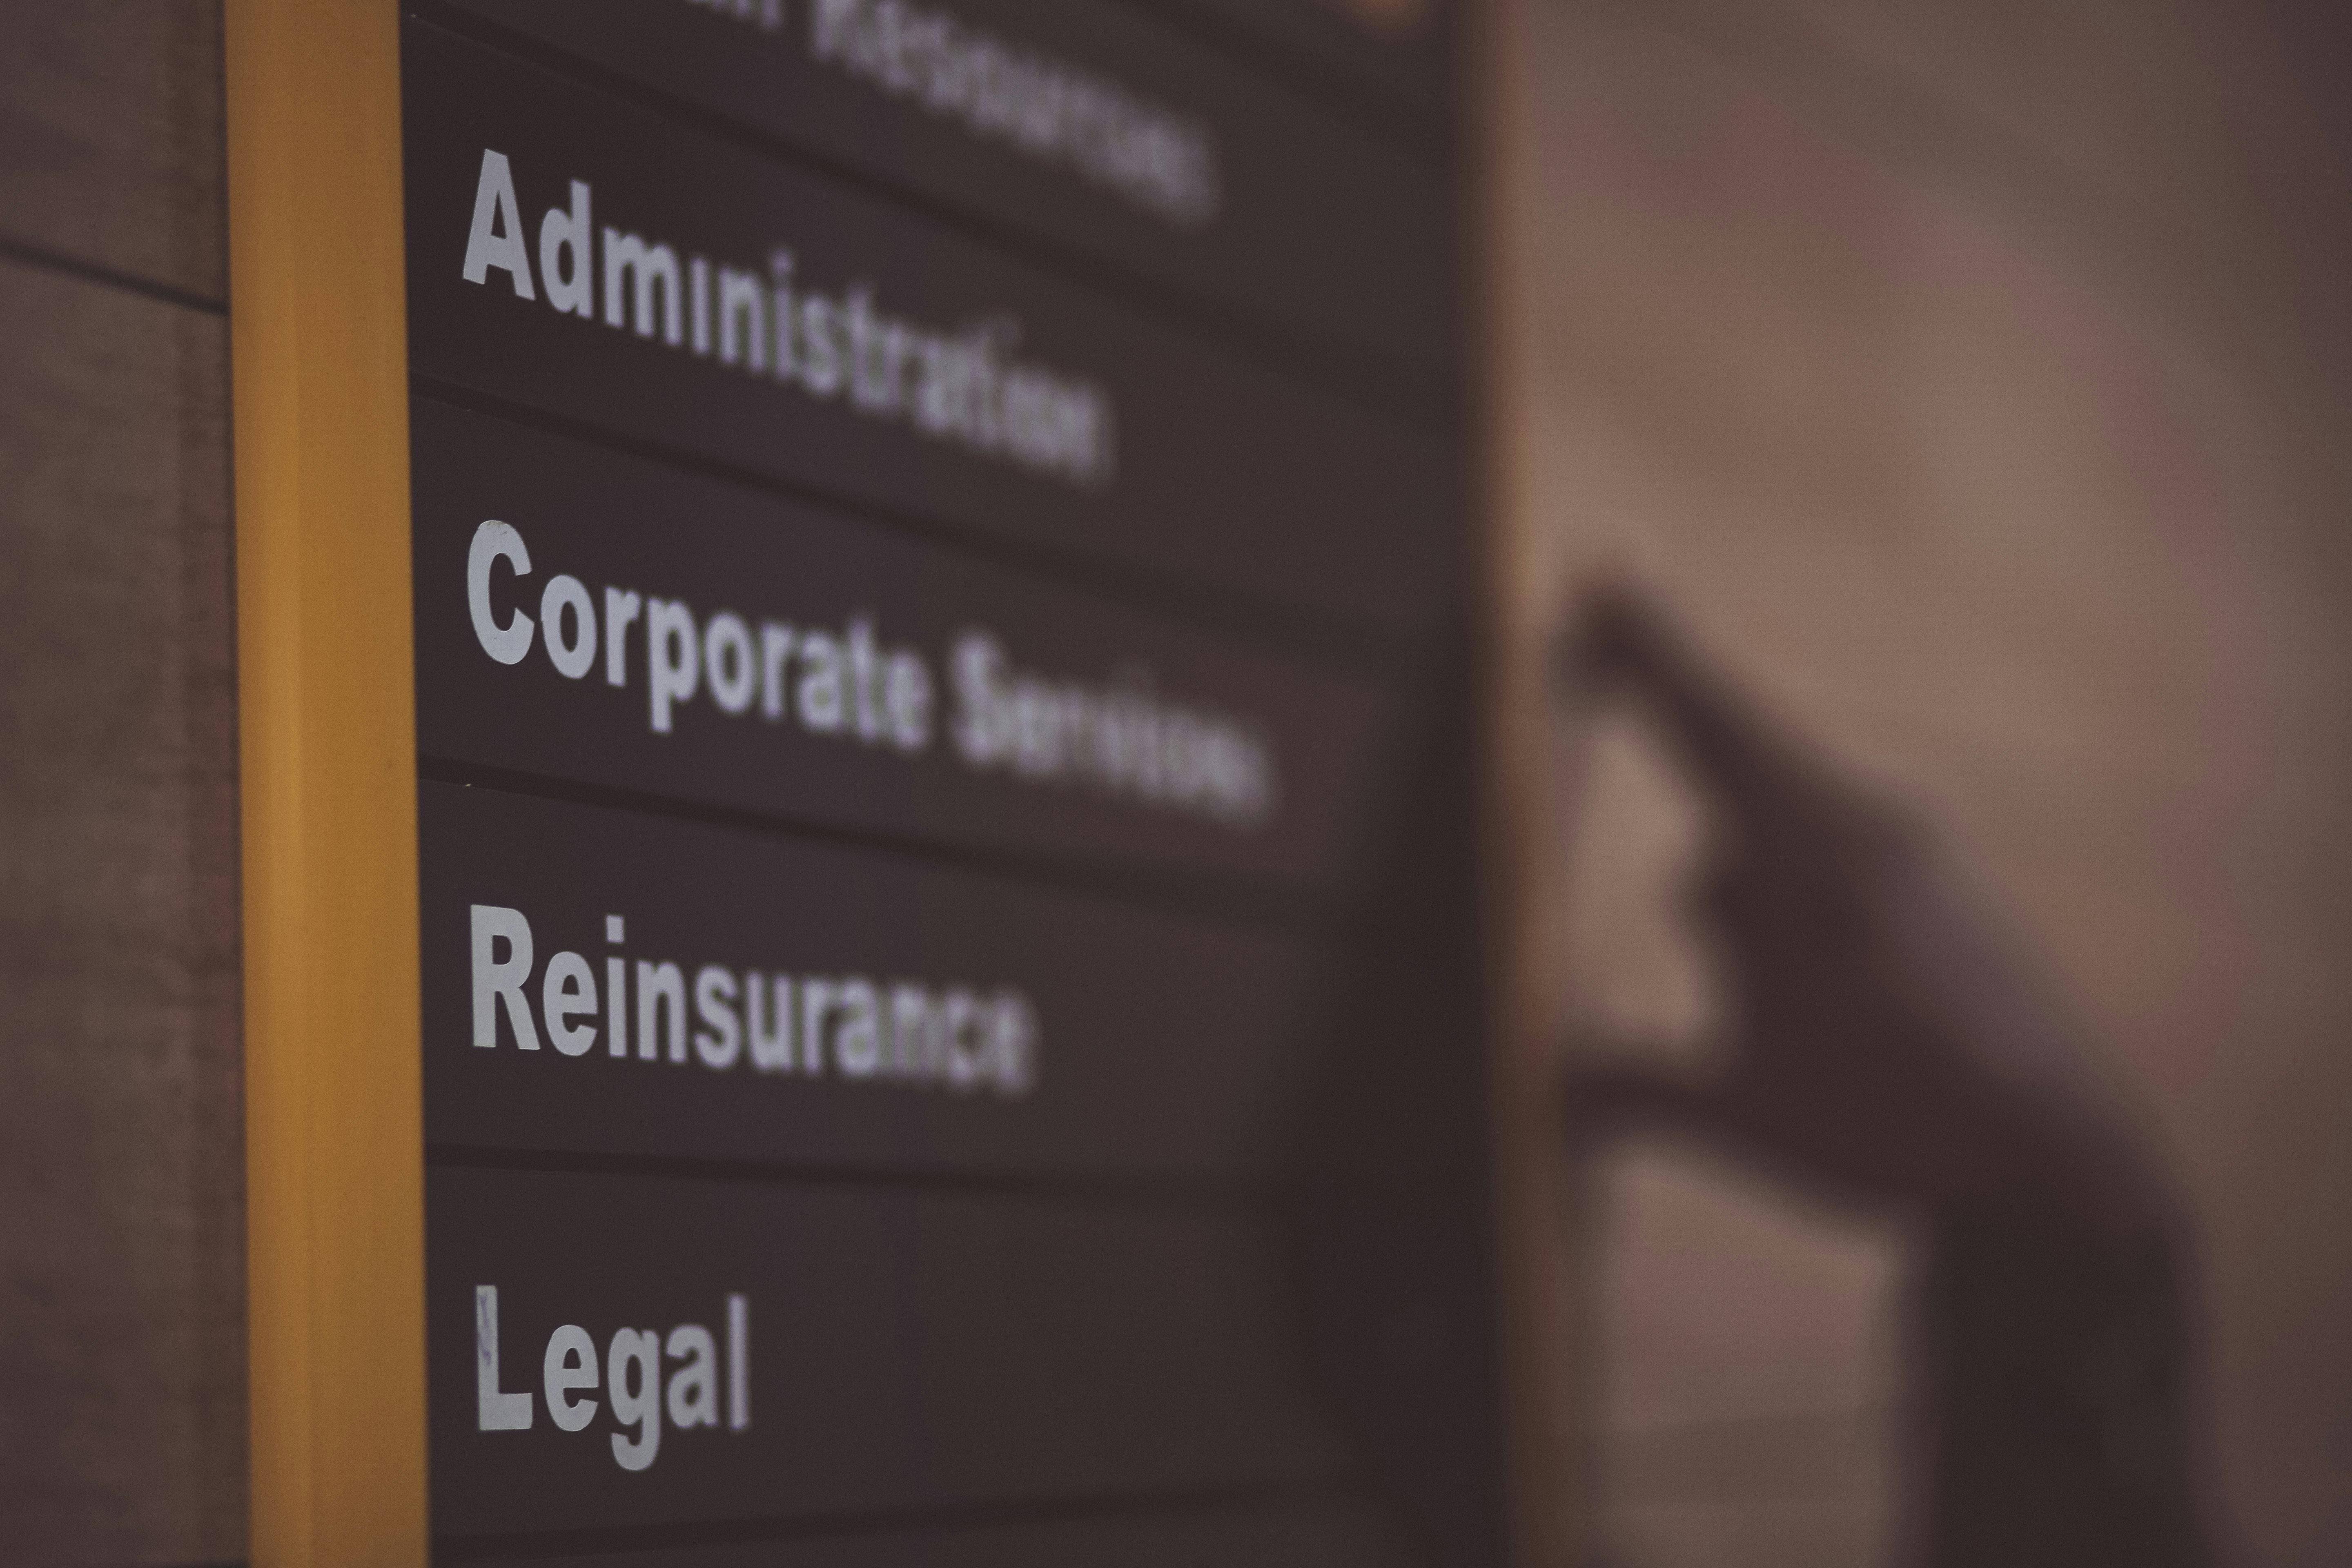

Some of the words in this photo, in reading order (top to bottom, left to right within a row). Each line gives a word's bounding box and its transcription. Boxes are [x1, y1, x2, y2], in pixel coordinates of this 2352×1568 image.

[462, 148, 1114, 486] Administration
[465, 518, 936, 755] Corporate
[469, 902, 1040, 1096] Reinsurance
[475, 1284, 751, 1472] Legal
